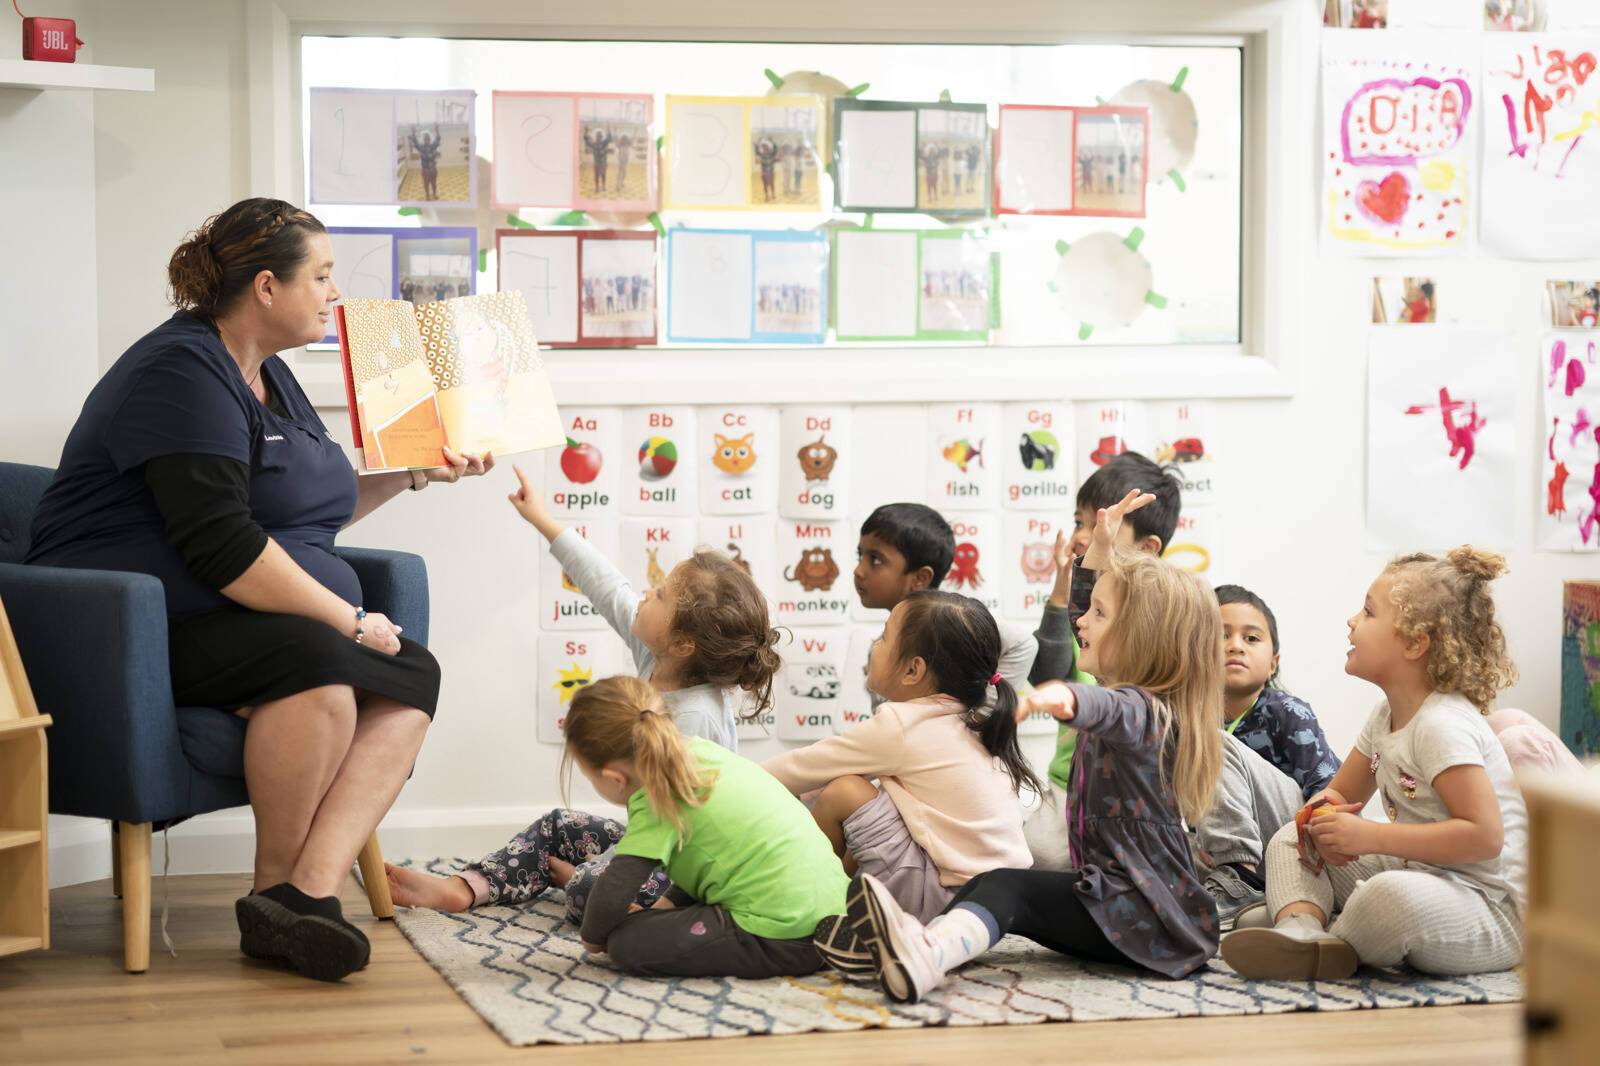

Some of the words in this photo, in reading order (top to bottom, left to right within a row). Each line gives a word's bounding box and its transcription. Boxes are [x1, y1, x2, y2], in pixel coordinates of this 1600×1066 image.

[42, 30, 69, 50] JBL
[687, 112, 732, 197] 3
[649, 413, 673, 427] Bb
[722, 413, 746, 426] Cc
[957, 409, 973, 423] Ff
[1028, 410, 1052, 428] Gg
[572, 416, 597, 431] Aa
[806, 417, 831, 431] Dd
[640, 488, 675, 501] ball
[721, 487, 752, 500] cat
[946, 482, 979, 496] fish
[1008, 481, 1067, 500] gorilla
[554, 491, 609, 510] apple
[798, 491, 834, 509] dog
[646, 528, 670, 542] Kk
[796, 525, 831, 539] Mm
[953, 523, 978, 536] Oo
[1028, 520, 1050, 536] Pp
[779, 598, 848, 613] monkey
[566, 641, 587, 655] Ss
[803, 640, 826, 652] Vv
[796, 714, 832, 726] van
